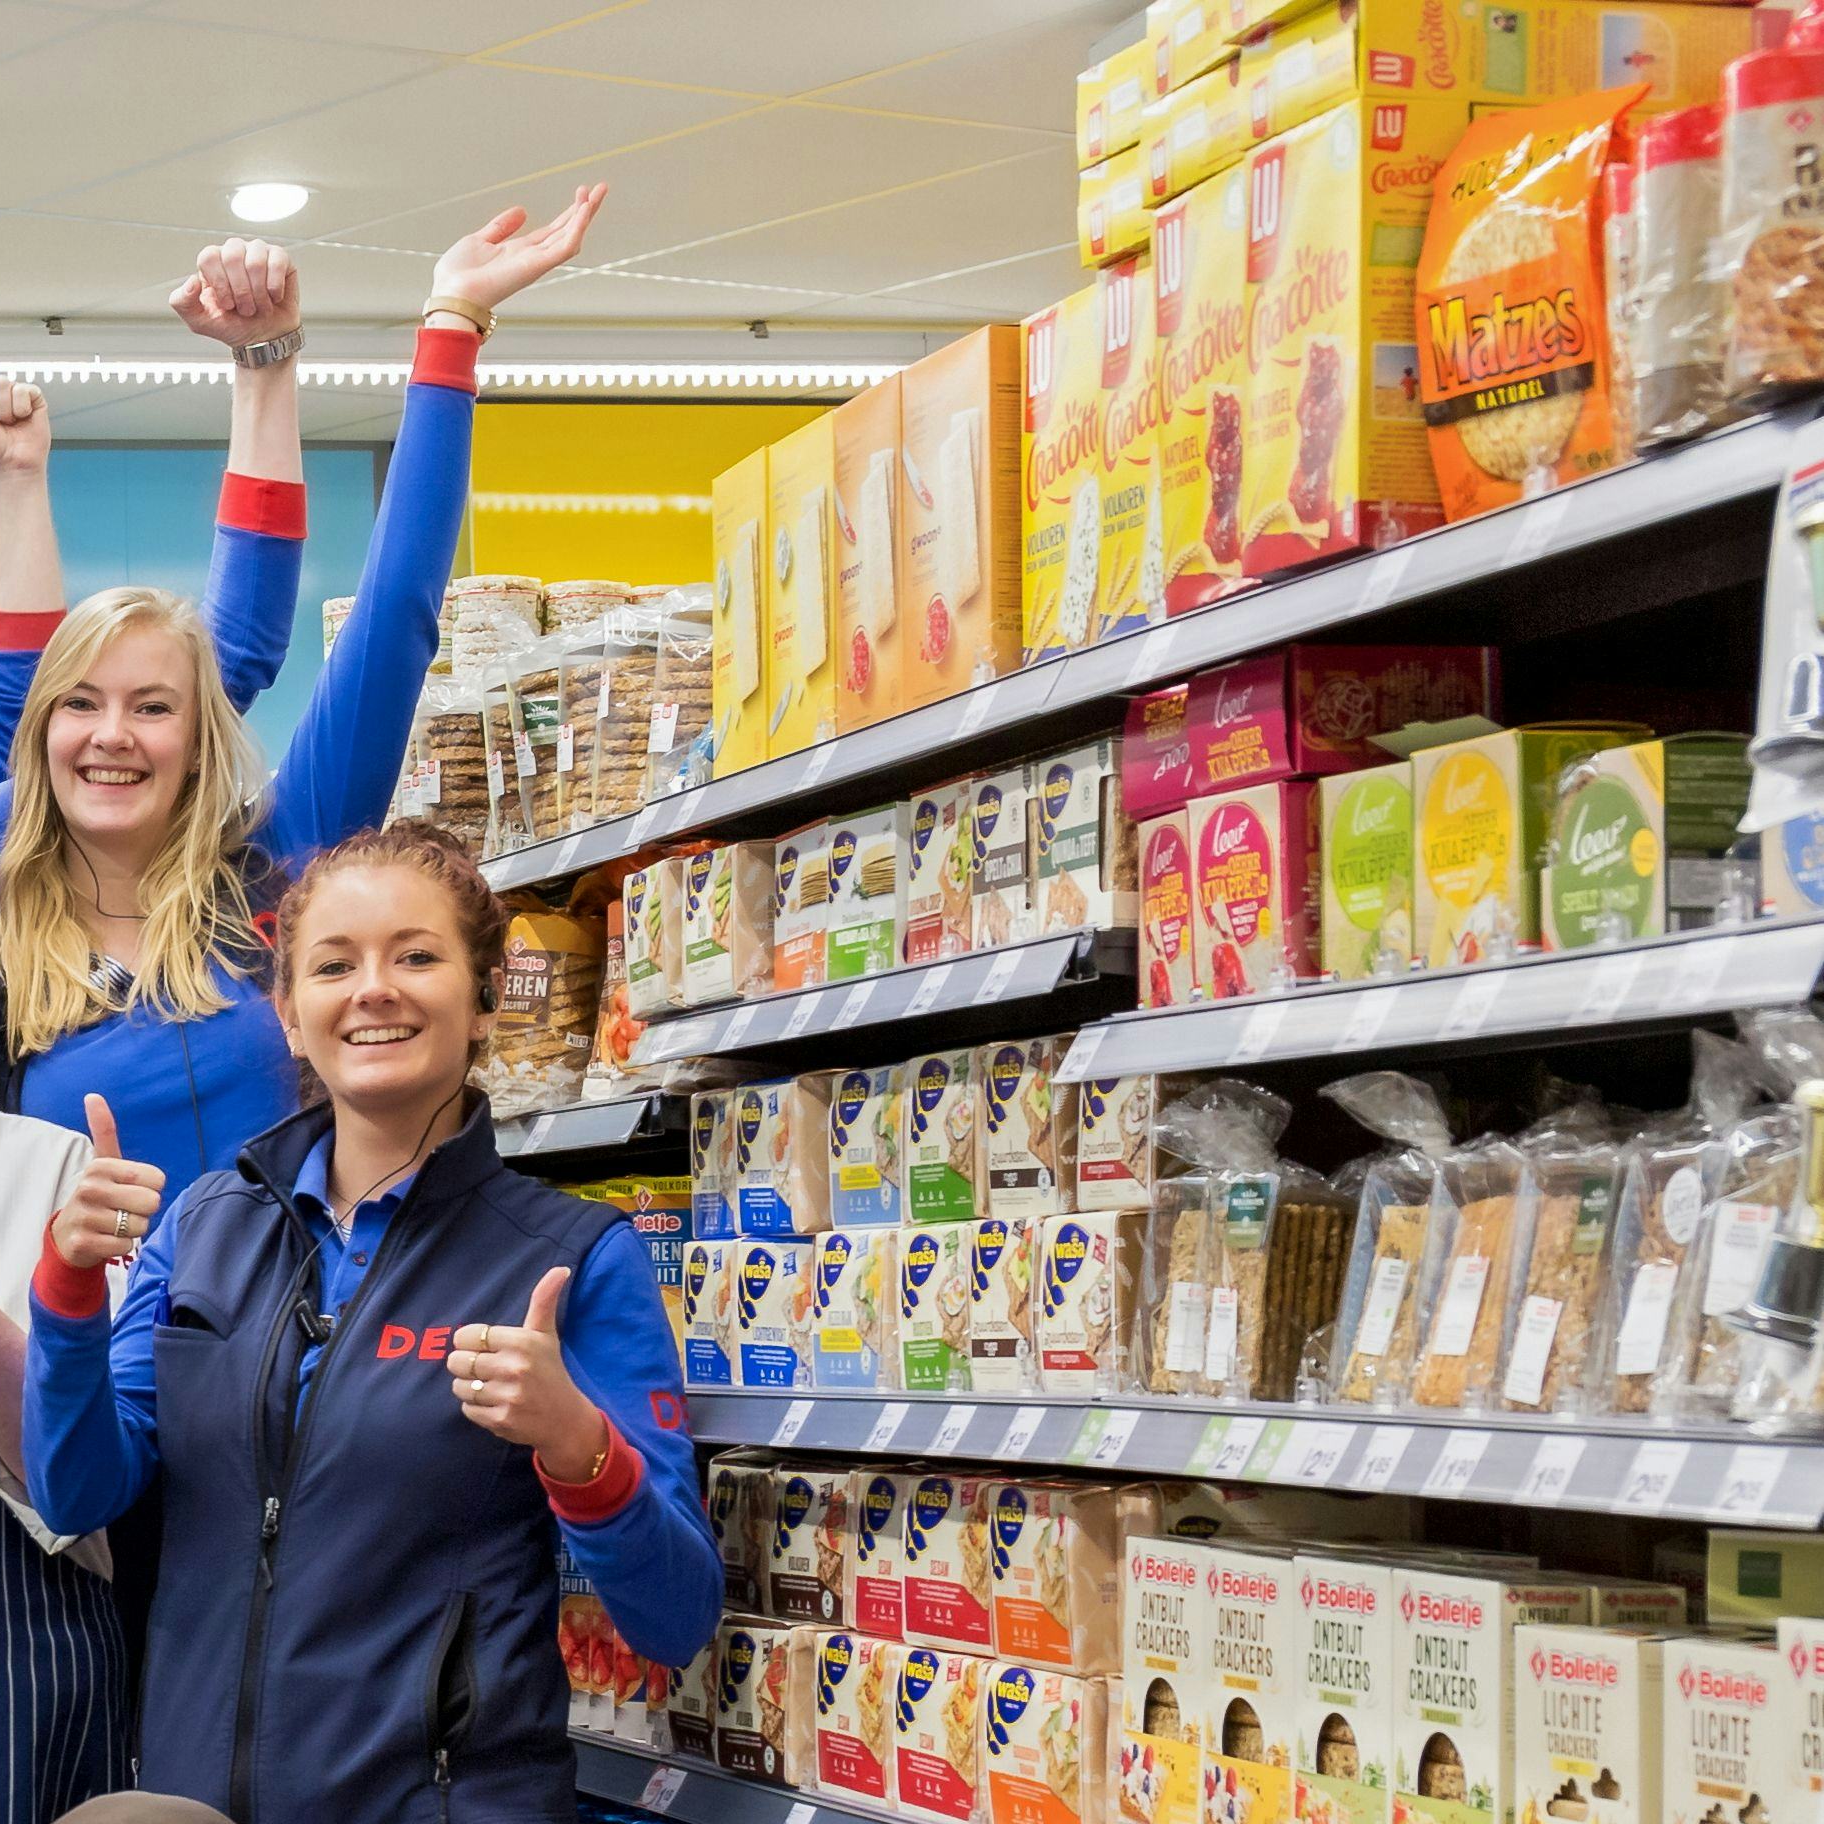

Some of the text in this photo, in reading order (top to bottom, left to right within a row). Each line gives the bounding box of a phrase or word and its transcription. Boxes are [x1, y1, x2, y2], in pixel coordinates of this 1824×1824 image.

[1376, 108, 1403, 139] LU
[1253, 158, 1281, 243] LU
[1157, 218, 1181, 298] LU
[1107, 276, 1131, 352] LU
[1248, 246, 1349, 376] Cracotte
[1428, 287, 1587, 393] Matzes
[1028, 325, 1052, 398] LU
[1161, 302, 1244, 425] Cracotte
[1476, 381, 1544, 411] NATUREL
[1103, 485, 1146, 519] VOLKOREN
[1026, 522, 1067, 556] VOLKOREN
[918, 1072, 947, 1090] wasa
[993, 1061, 1023, 1079] wasa
[841, 1086, 869, 1103] wasa
[741, 1107, 763, 1122] wasa
[977, 1232, 1005, 1247] wasa
[1055, 1242, 1085, 1259] wasa
[690, 1261, 705, 1275] wasa
[745, 1264, 773, 1280] wasa
[824, 1249, 848, 1266] wasa
[908, 1248, 937, 1266] wasa
[376, 1324, 454, 1360] DE
[917, 1489, 949, 1508] wasa
[996, 1504, 1025, 1523] wasa
[1145, 1558, 1197, 1587] Bolletje
[1222, 1572, 1278, 1601] Bolletje
[1140, 1591, 1185, 1626] ONTBIJT
[1317, 1582, 1376, 1613] Bolletje
[1418, 1595, 1483, 1627] Bolletje
[1136, 1621, 1191, 1659] CRACKERS
[1219, 1607, 1266, 1642] ONTBIJT
[1313, 1619, 1364, 1656] ONTBIJT
[825, 1648, 851, 1665] wasa
[1214, 1638, 1274, 1677] CRACKERS
[1415, 1634, 1470, 1671] ONTBIJT
[906, 1661, 935, 1680] wasa
[1307, 1651, 1371, 1692] CRACKERS
[1550, 1653, 1618, 1685] Bolletje
[996, 1681, 1030, 1702] wasa
[1409, 1667, 1478, 1710] CRACKERS
[1699, 1671, 1767, 1705] Bolletje
[1543, 1691, 1603, 1734] LICHTE
[1547, 1732, 1599, 1761] CRACKERS
[1691, 1708, 1751, 1756] LICHTE
[1695, 1753, 1747, 1784] CRACKERS
